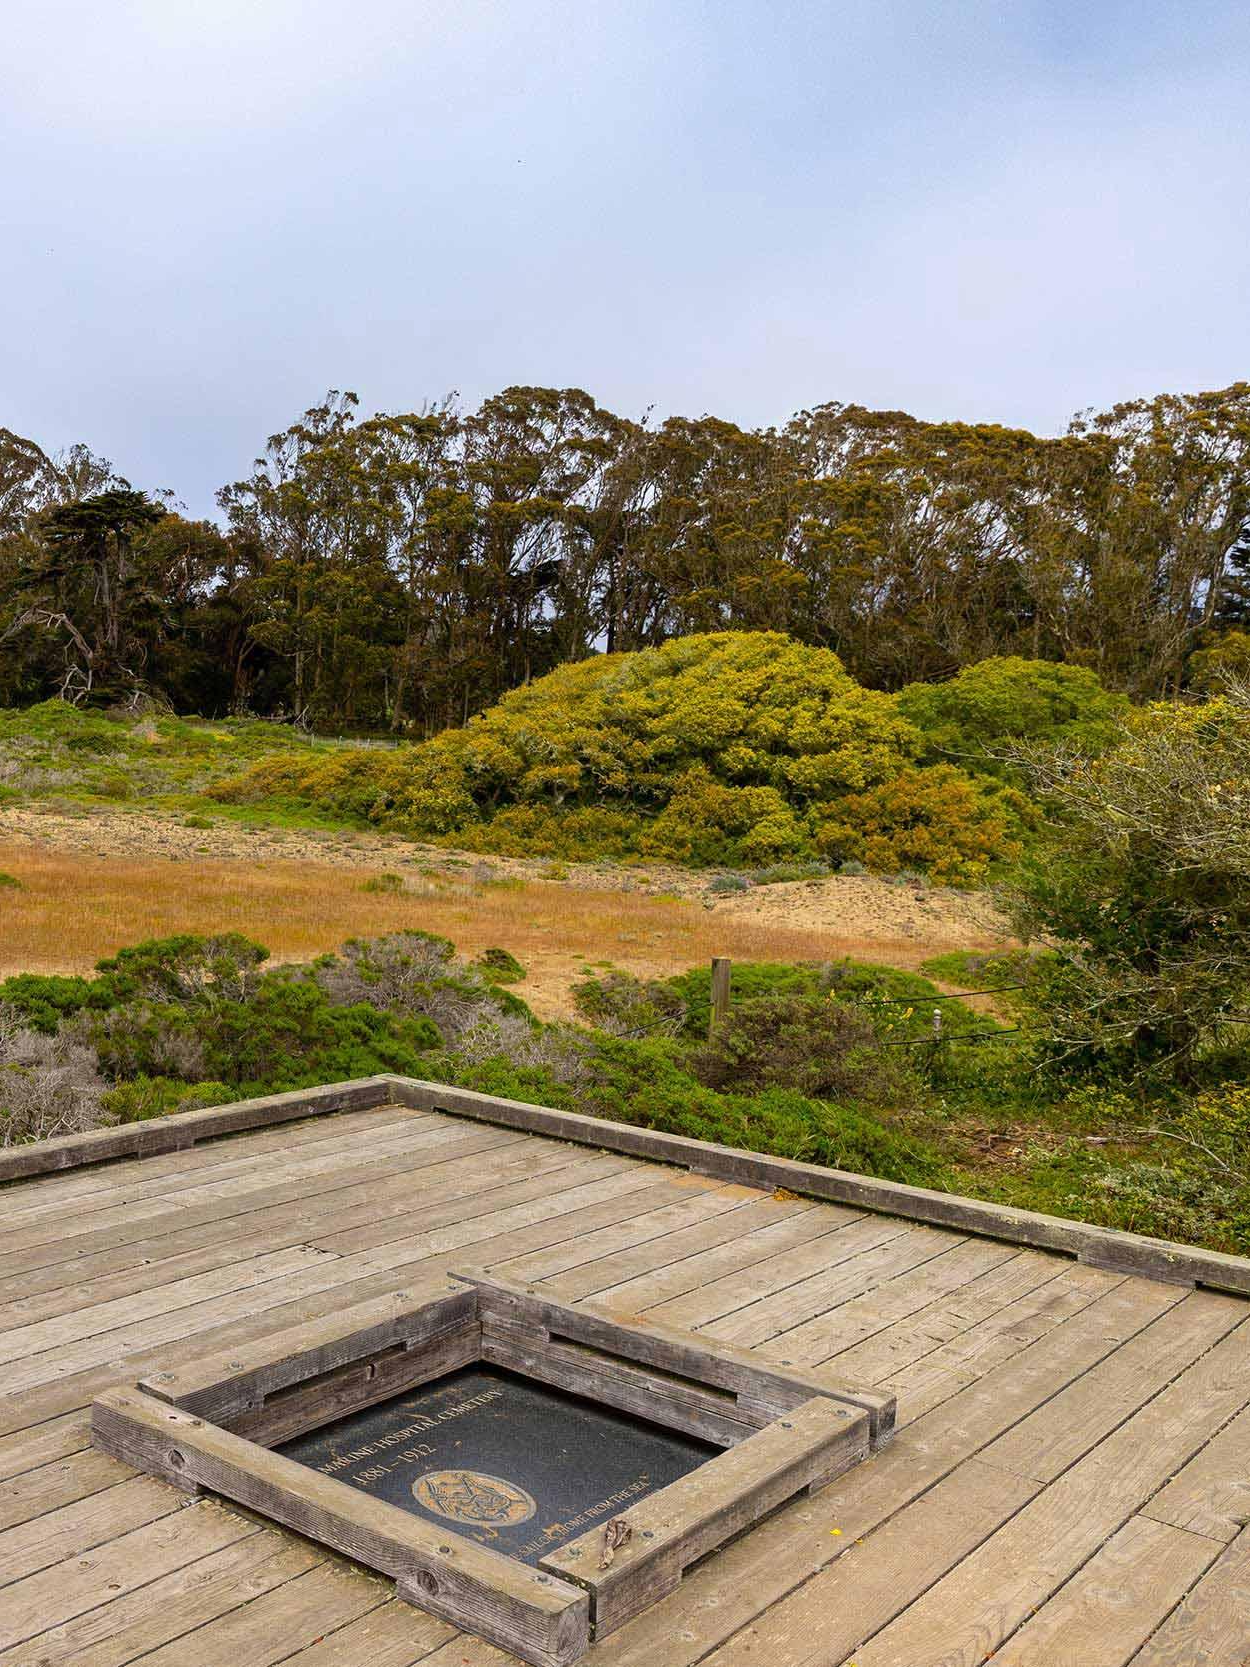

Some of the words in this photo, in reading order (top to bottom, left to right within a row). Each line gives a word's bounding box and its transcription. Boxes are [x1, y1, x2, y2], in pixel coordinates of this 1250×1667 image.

[318, 1445, 378, 1474] MARINE
[374, 1417, 442, 1449] HOSPITAL
[437, 1390, 502, 1419] CEMETERY
[352, 1464, 391, 1486] 1881
[397, 1443, 438, 1463] 1912
[557, 1513, 591, 1536] HOME
[584, 1499, 616, 1518] FROM
[608, 1488, 633, 1503] THE
